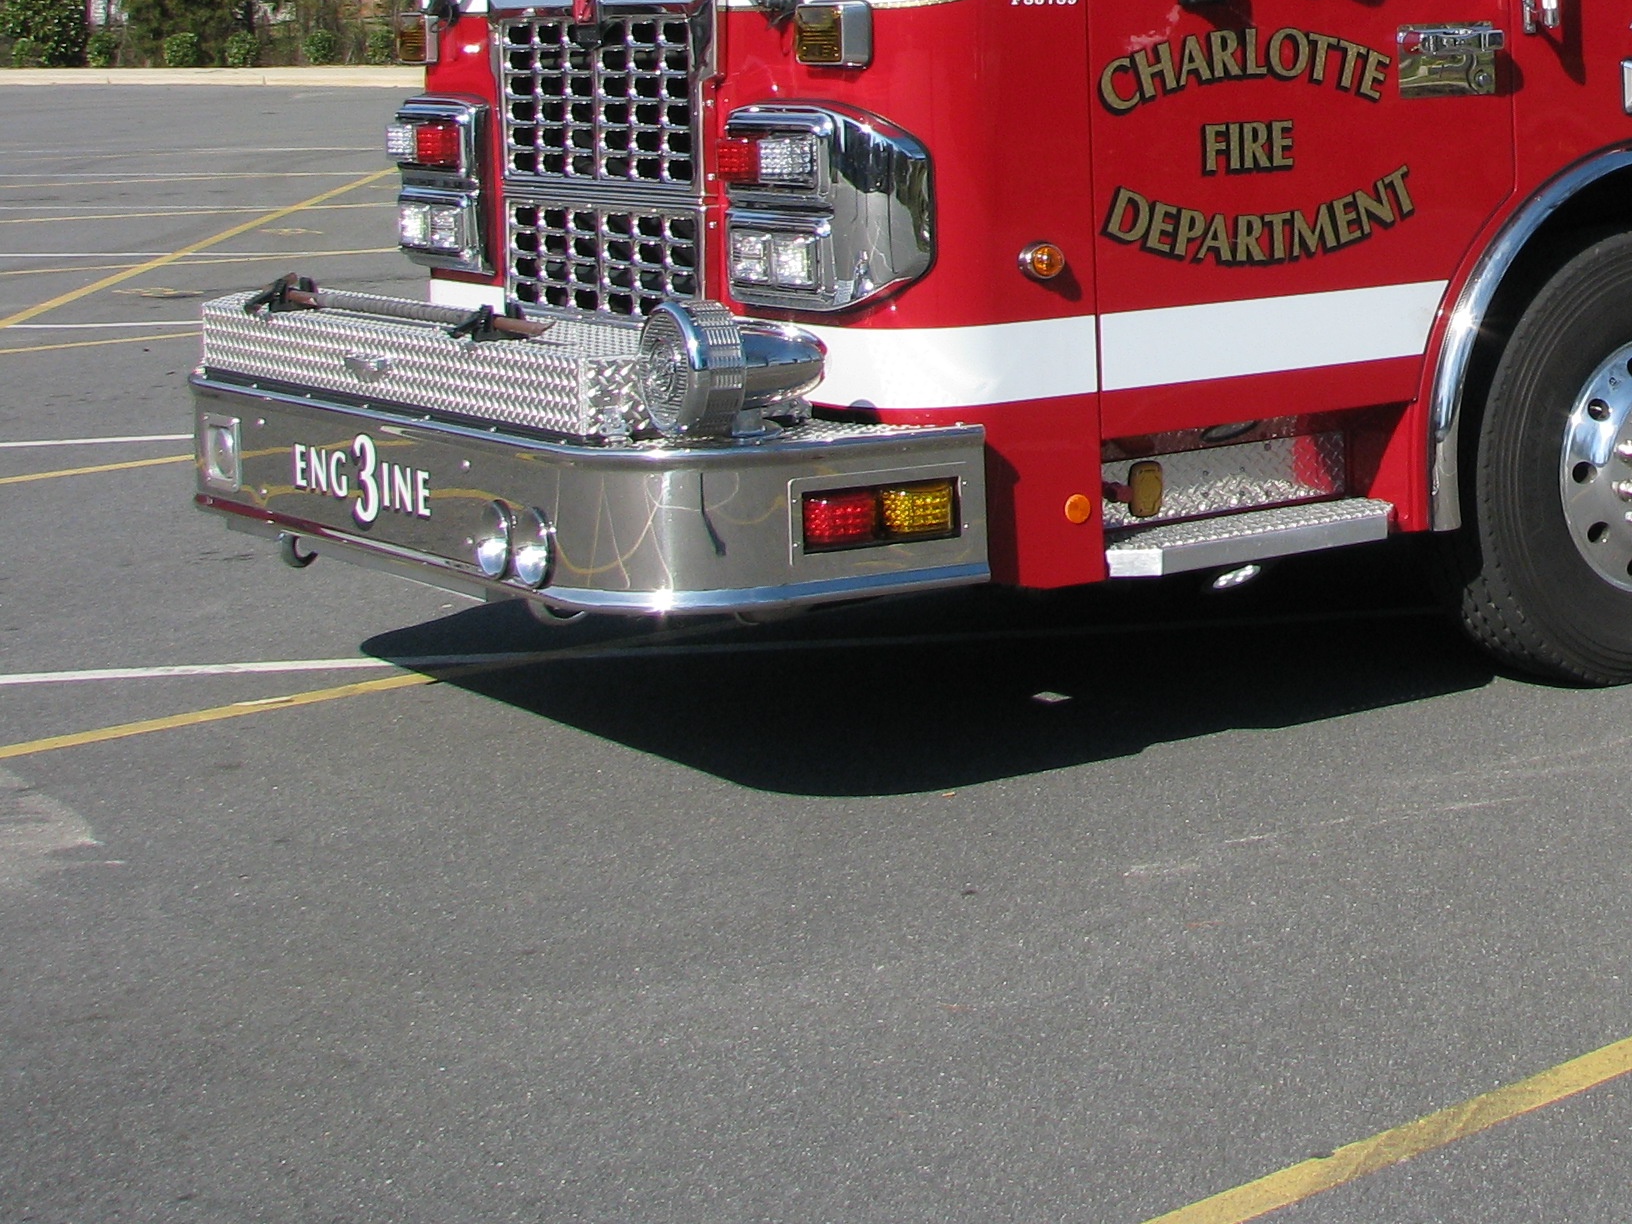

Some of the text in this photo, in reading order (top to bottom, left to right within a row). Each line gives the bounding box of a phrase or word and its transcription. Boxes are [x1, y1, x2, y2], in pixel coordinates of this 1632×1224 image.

[1100, 26, 1391, 112] CHARLOTTE
[1203, 119, 1294, 174] FIRE
[1102, 163, 1416, 265] DEPARTMENT
